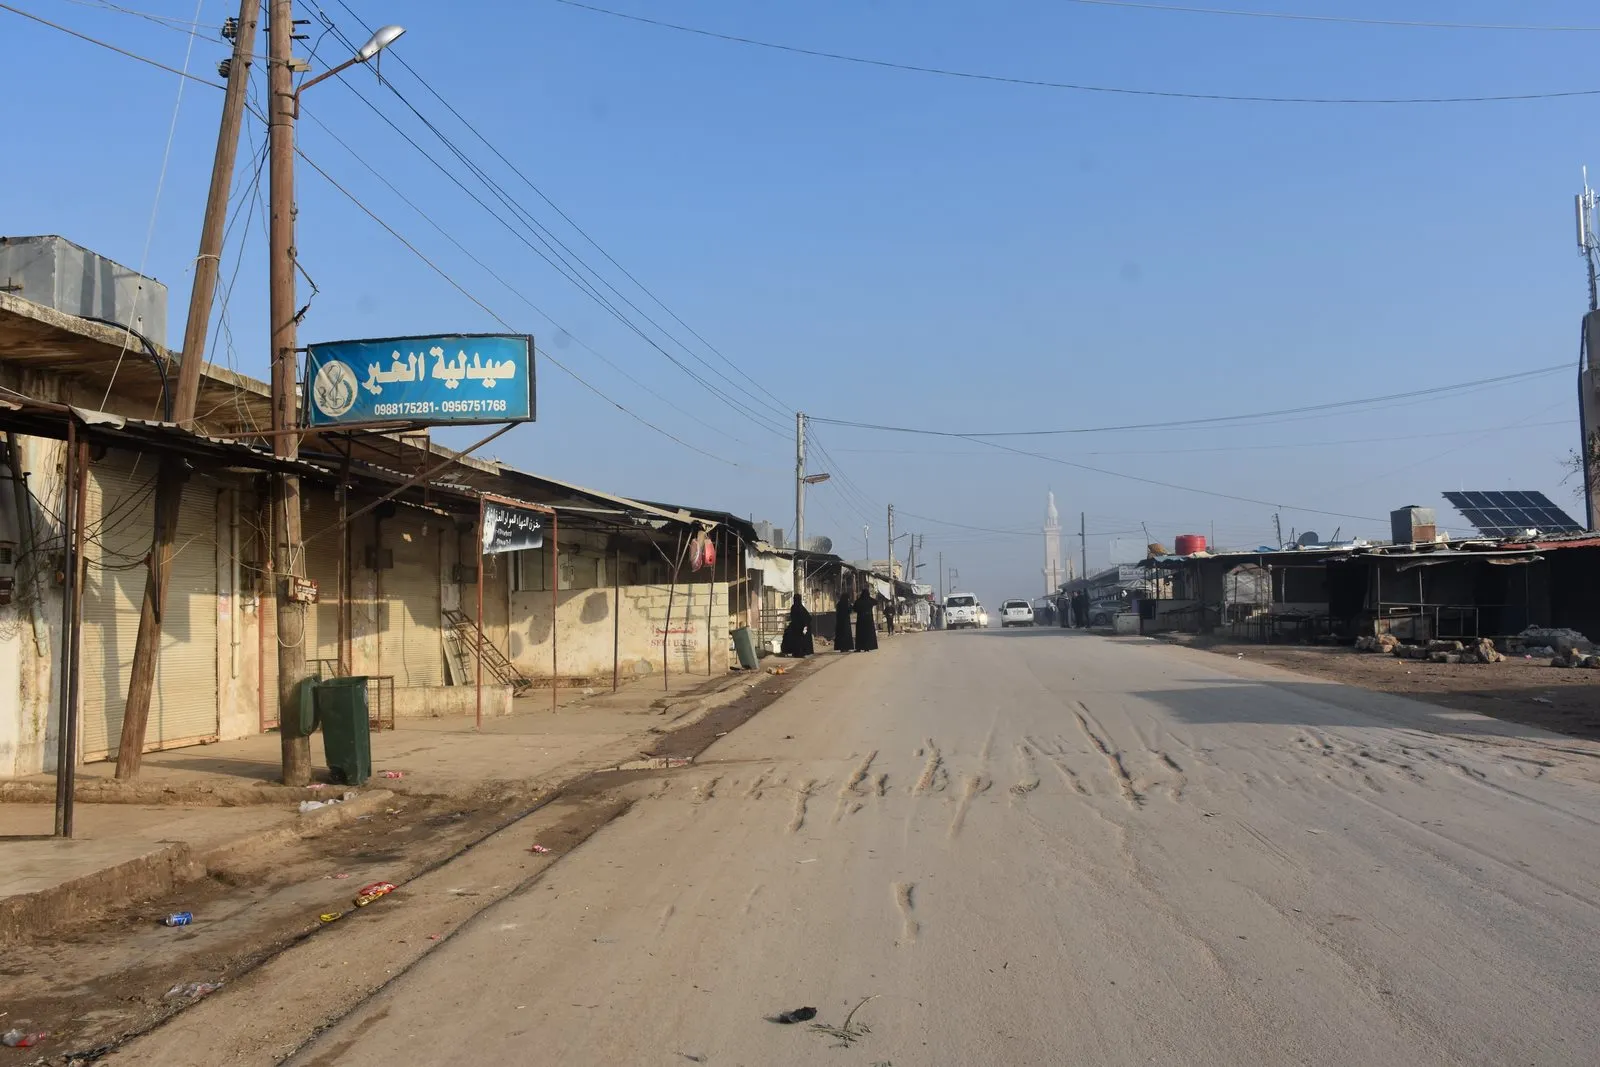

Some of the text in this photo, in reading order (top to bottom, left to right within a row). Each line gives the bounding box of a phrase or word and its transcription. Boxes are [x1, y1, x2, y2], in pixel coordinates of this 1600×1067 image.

[362, 346, 516, 395] صيدلية الخير
[441, 400, 506, 412] 0956751768
